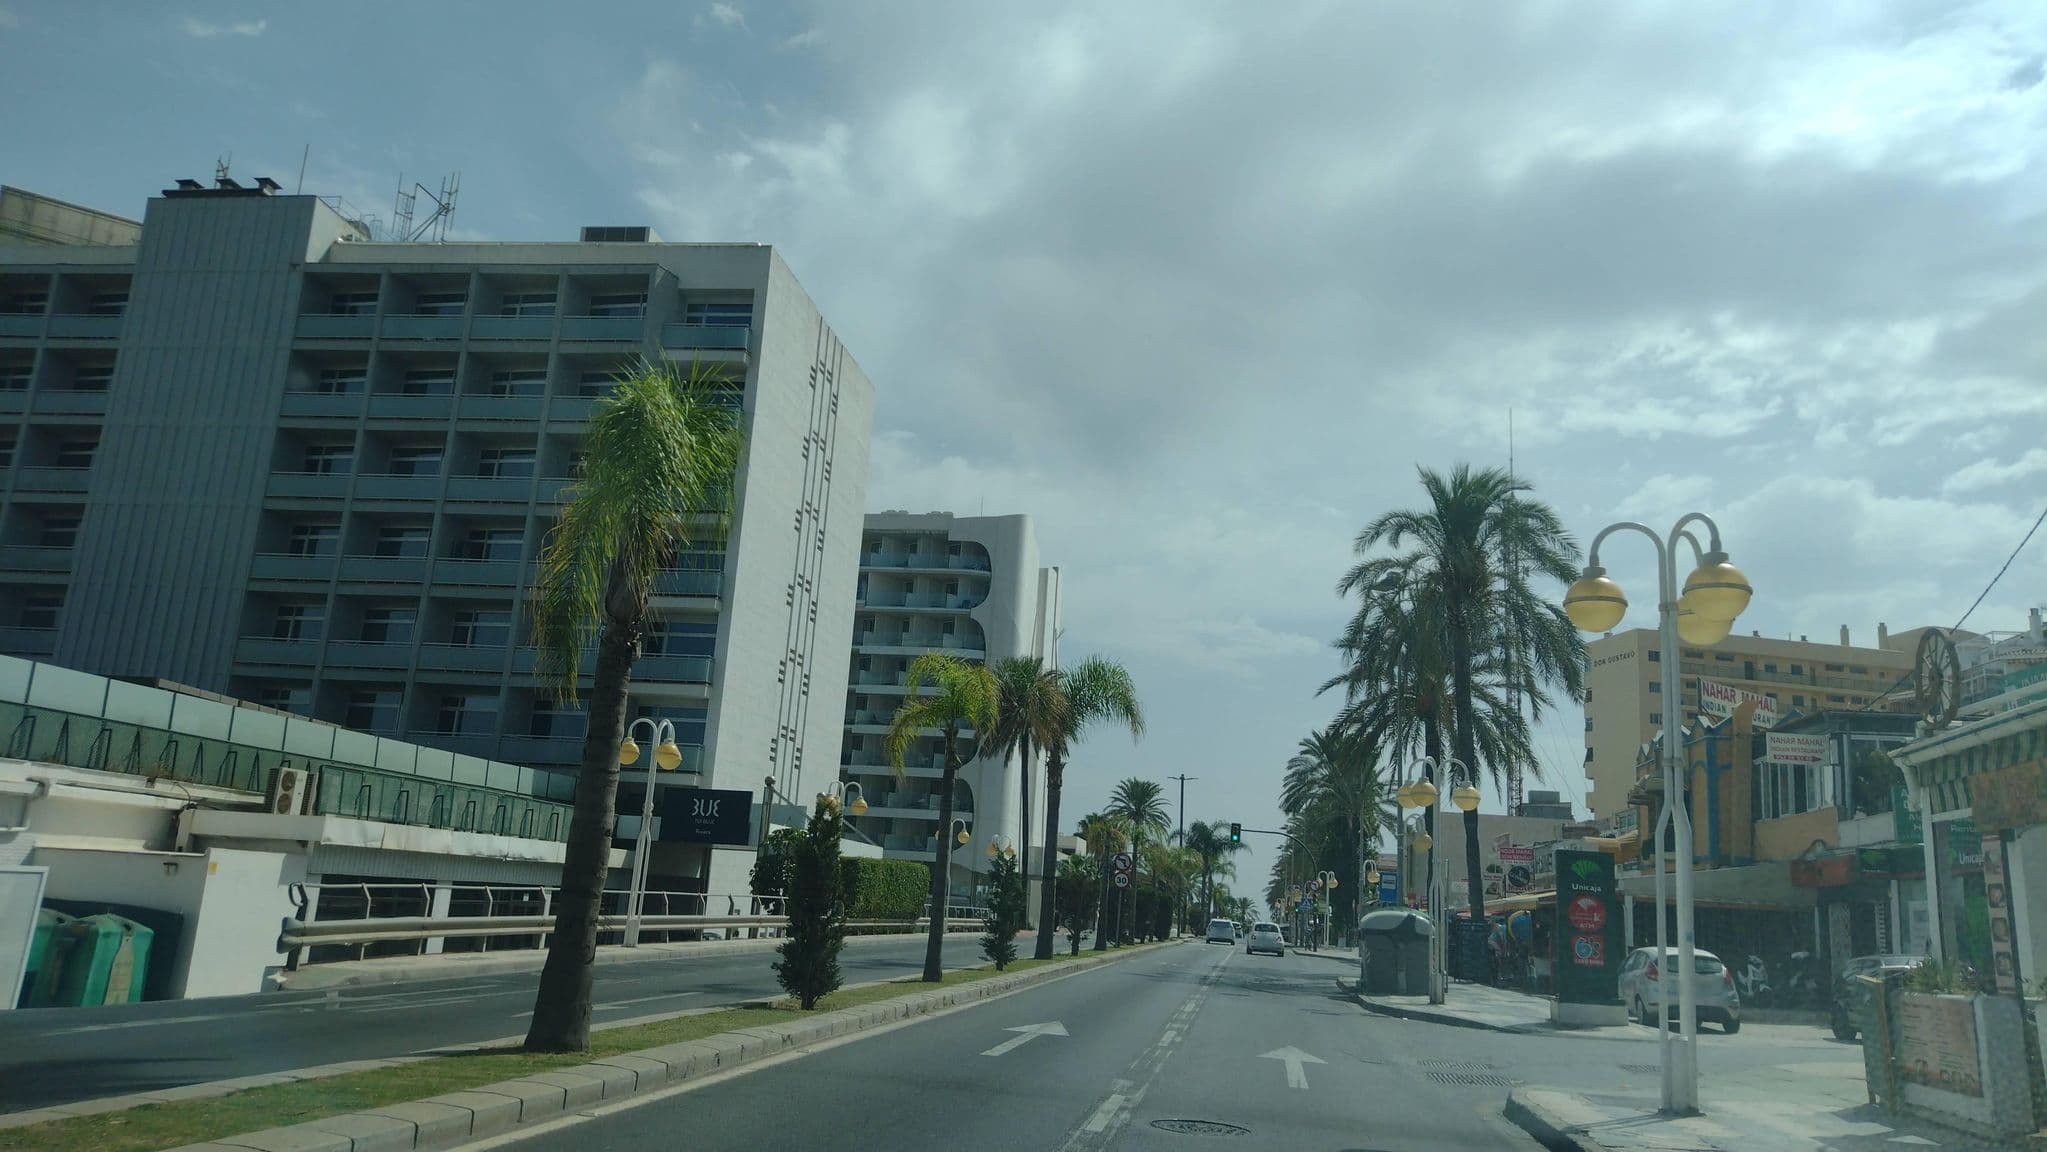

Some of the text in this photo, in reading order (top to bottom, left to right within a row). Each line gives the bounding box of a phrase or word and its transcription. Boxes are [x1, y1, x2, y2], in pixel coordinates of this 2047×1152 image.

[1702, 681, 1736, 703] NAHAR
[1702, 701, 1727, 714] INDIAN
[1771, 736, 1825, 745] NAHAR MAHAL
[1116, 876, 1127, 884] 30
[1572, 883, 1602, 893] Unicaja
